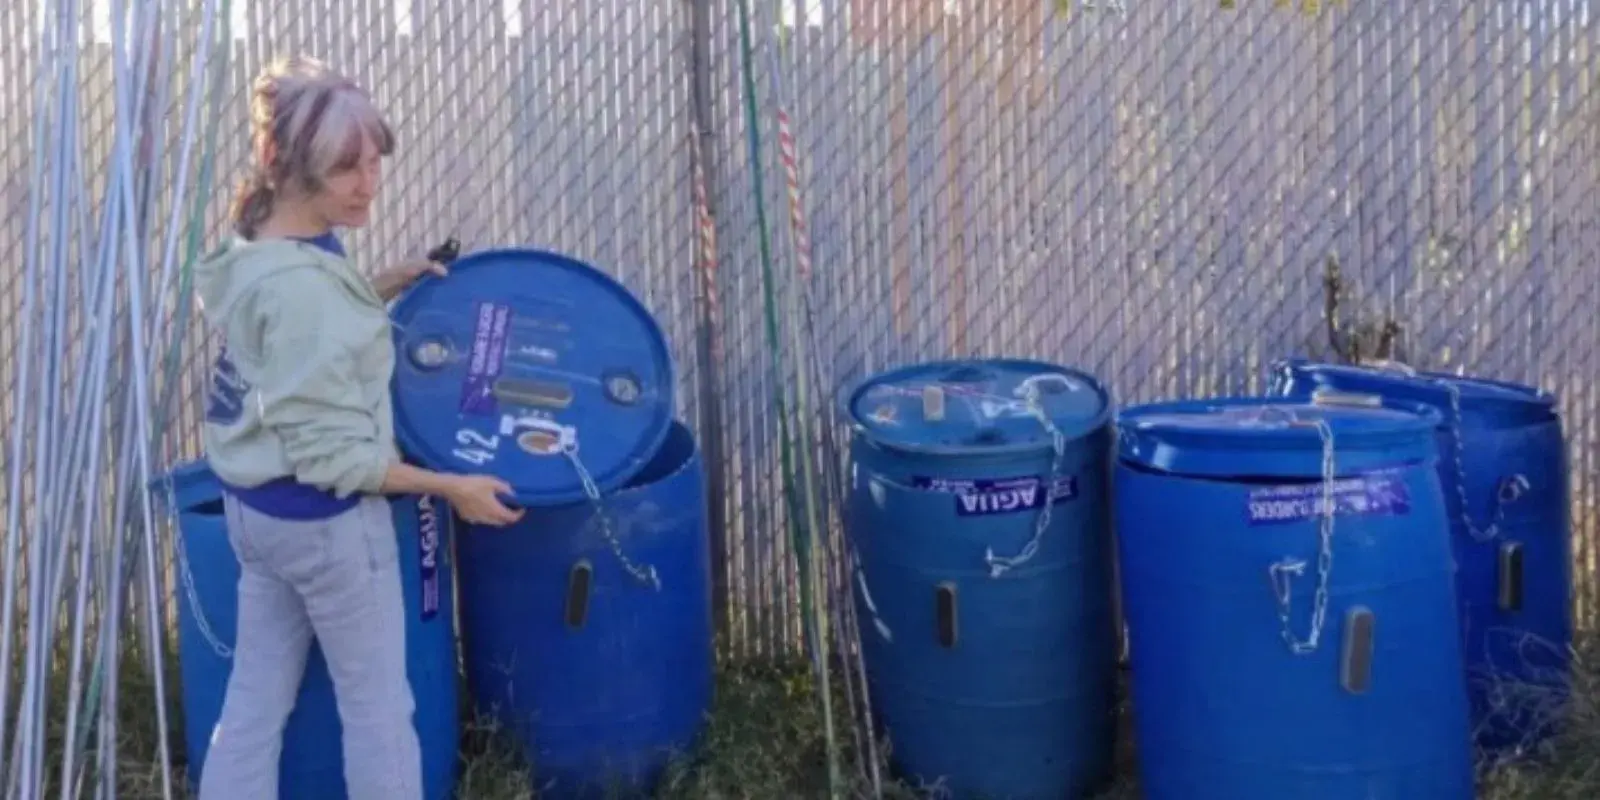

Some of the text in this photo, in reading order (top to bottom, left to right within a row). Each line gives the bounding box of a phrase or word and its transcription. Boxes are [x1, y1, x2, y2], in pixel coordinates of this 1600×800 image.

[453, 429, 499, 466] 42
[962, 485, 1037, 513] AGUA
[419, 493, 438, 568] AGUA
